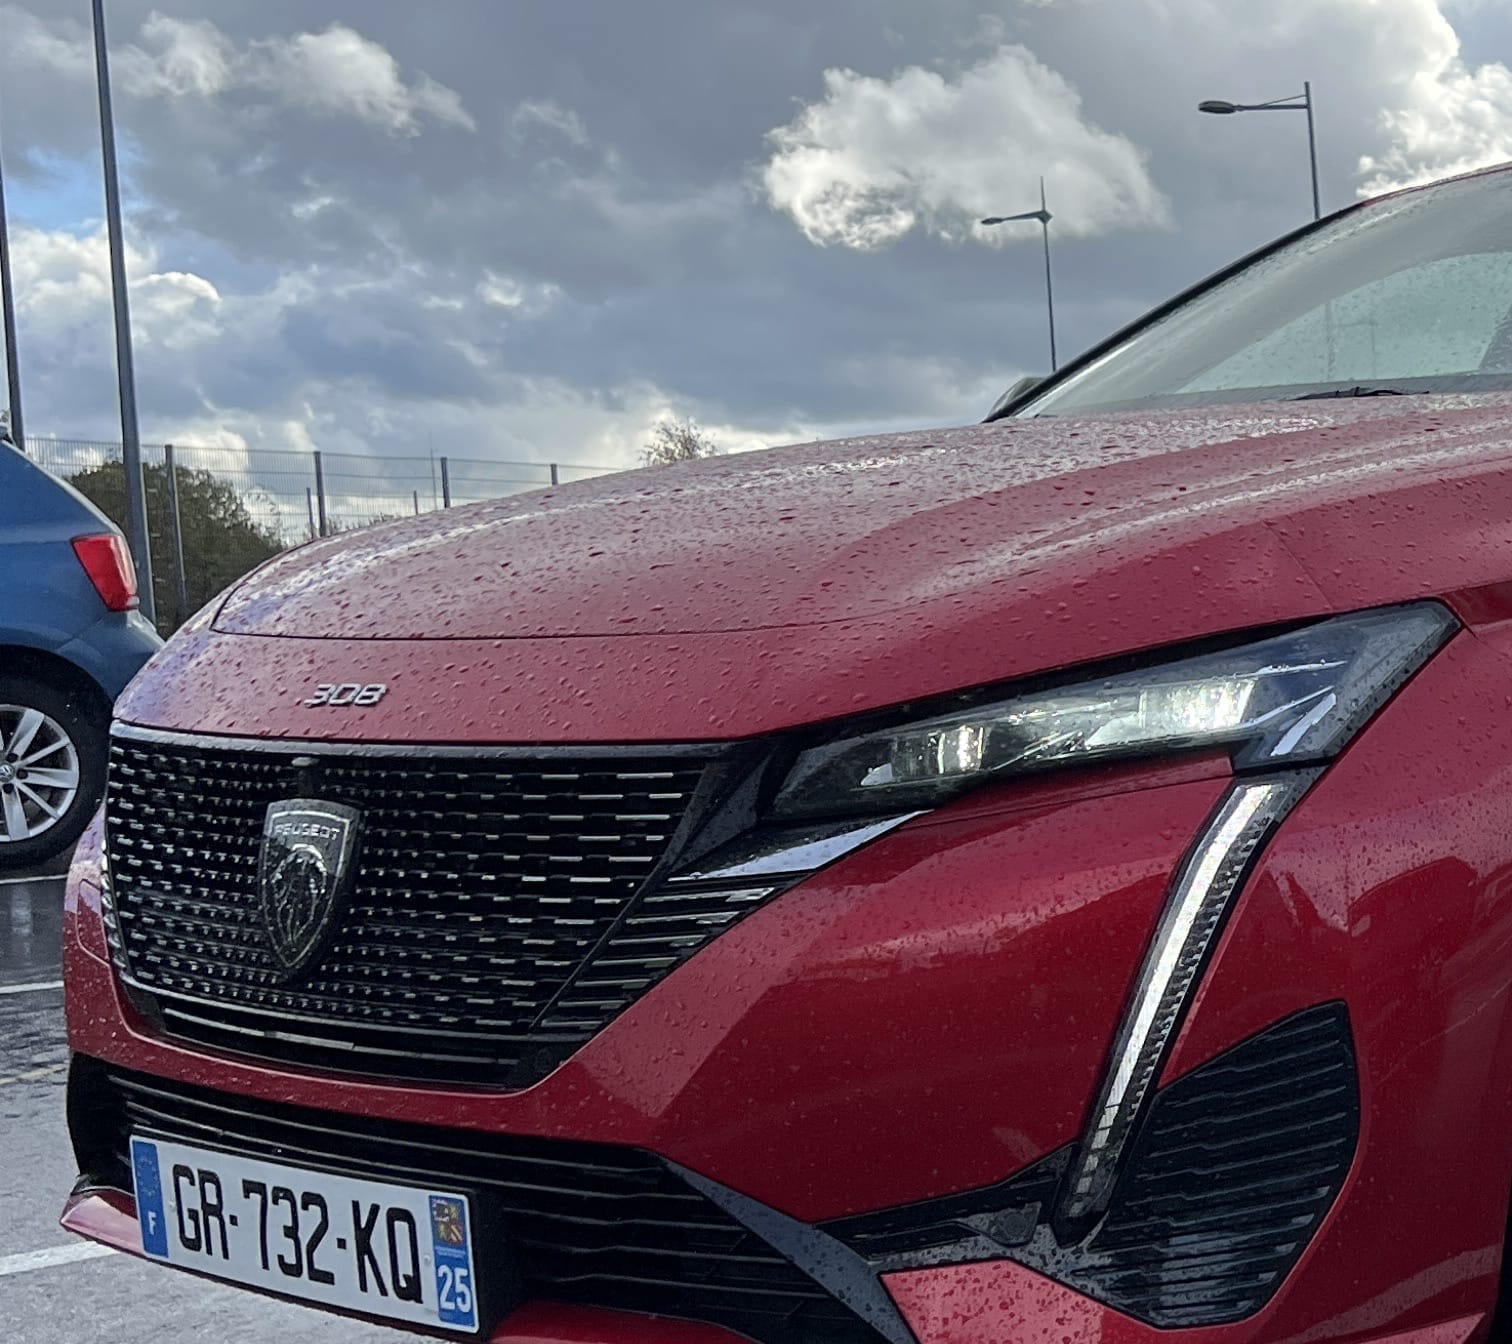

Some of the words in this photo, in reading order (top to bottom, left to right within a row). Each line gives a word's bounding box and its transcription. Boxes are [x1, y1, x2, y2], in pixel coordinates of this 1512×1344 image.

[304, 683, 387, 706] 308
[274, 823, 341, 840] PEUGEOT
[148, 1211, 157, 1236] F
[172, 1164, 424, 1305] GR-732-KQ
[437, 1264, 471, 1313] 25
